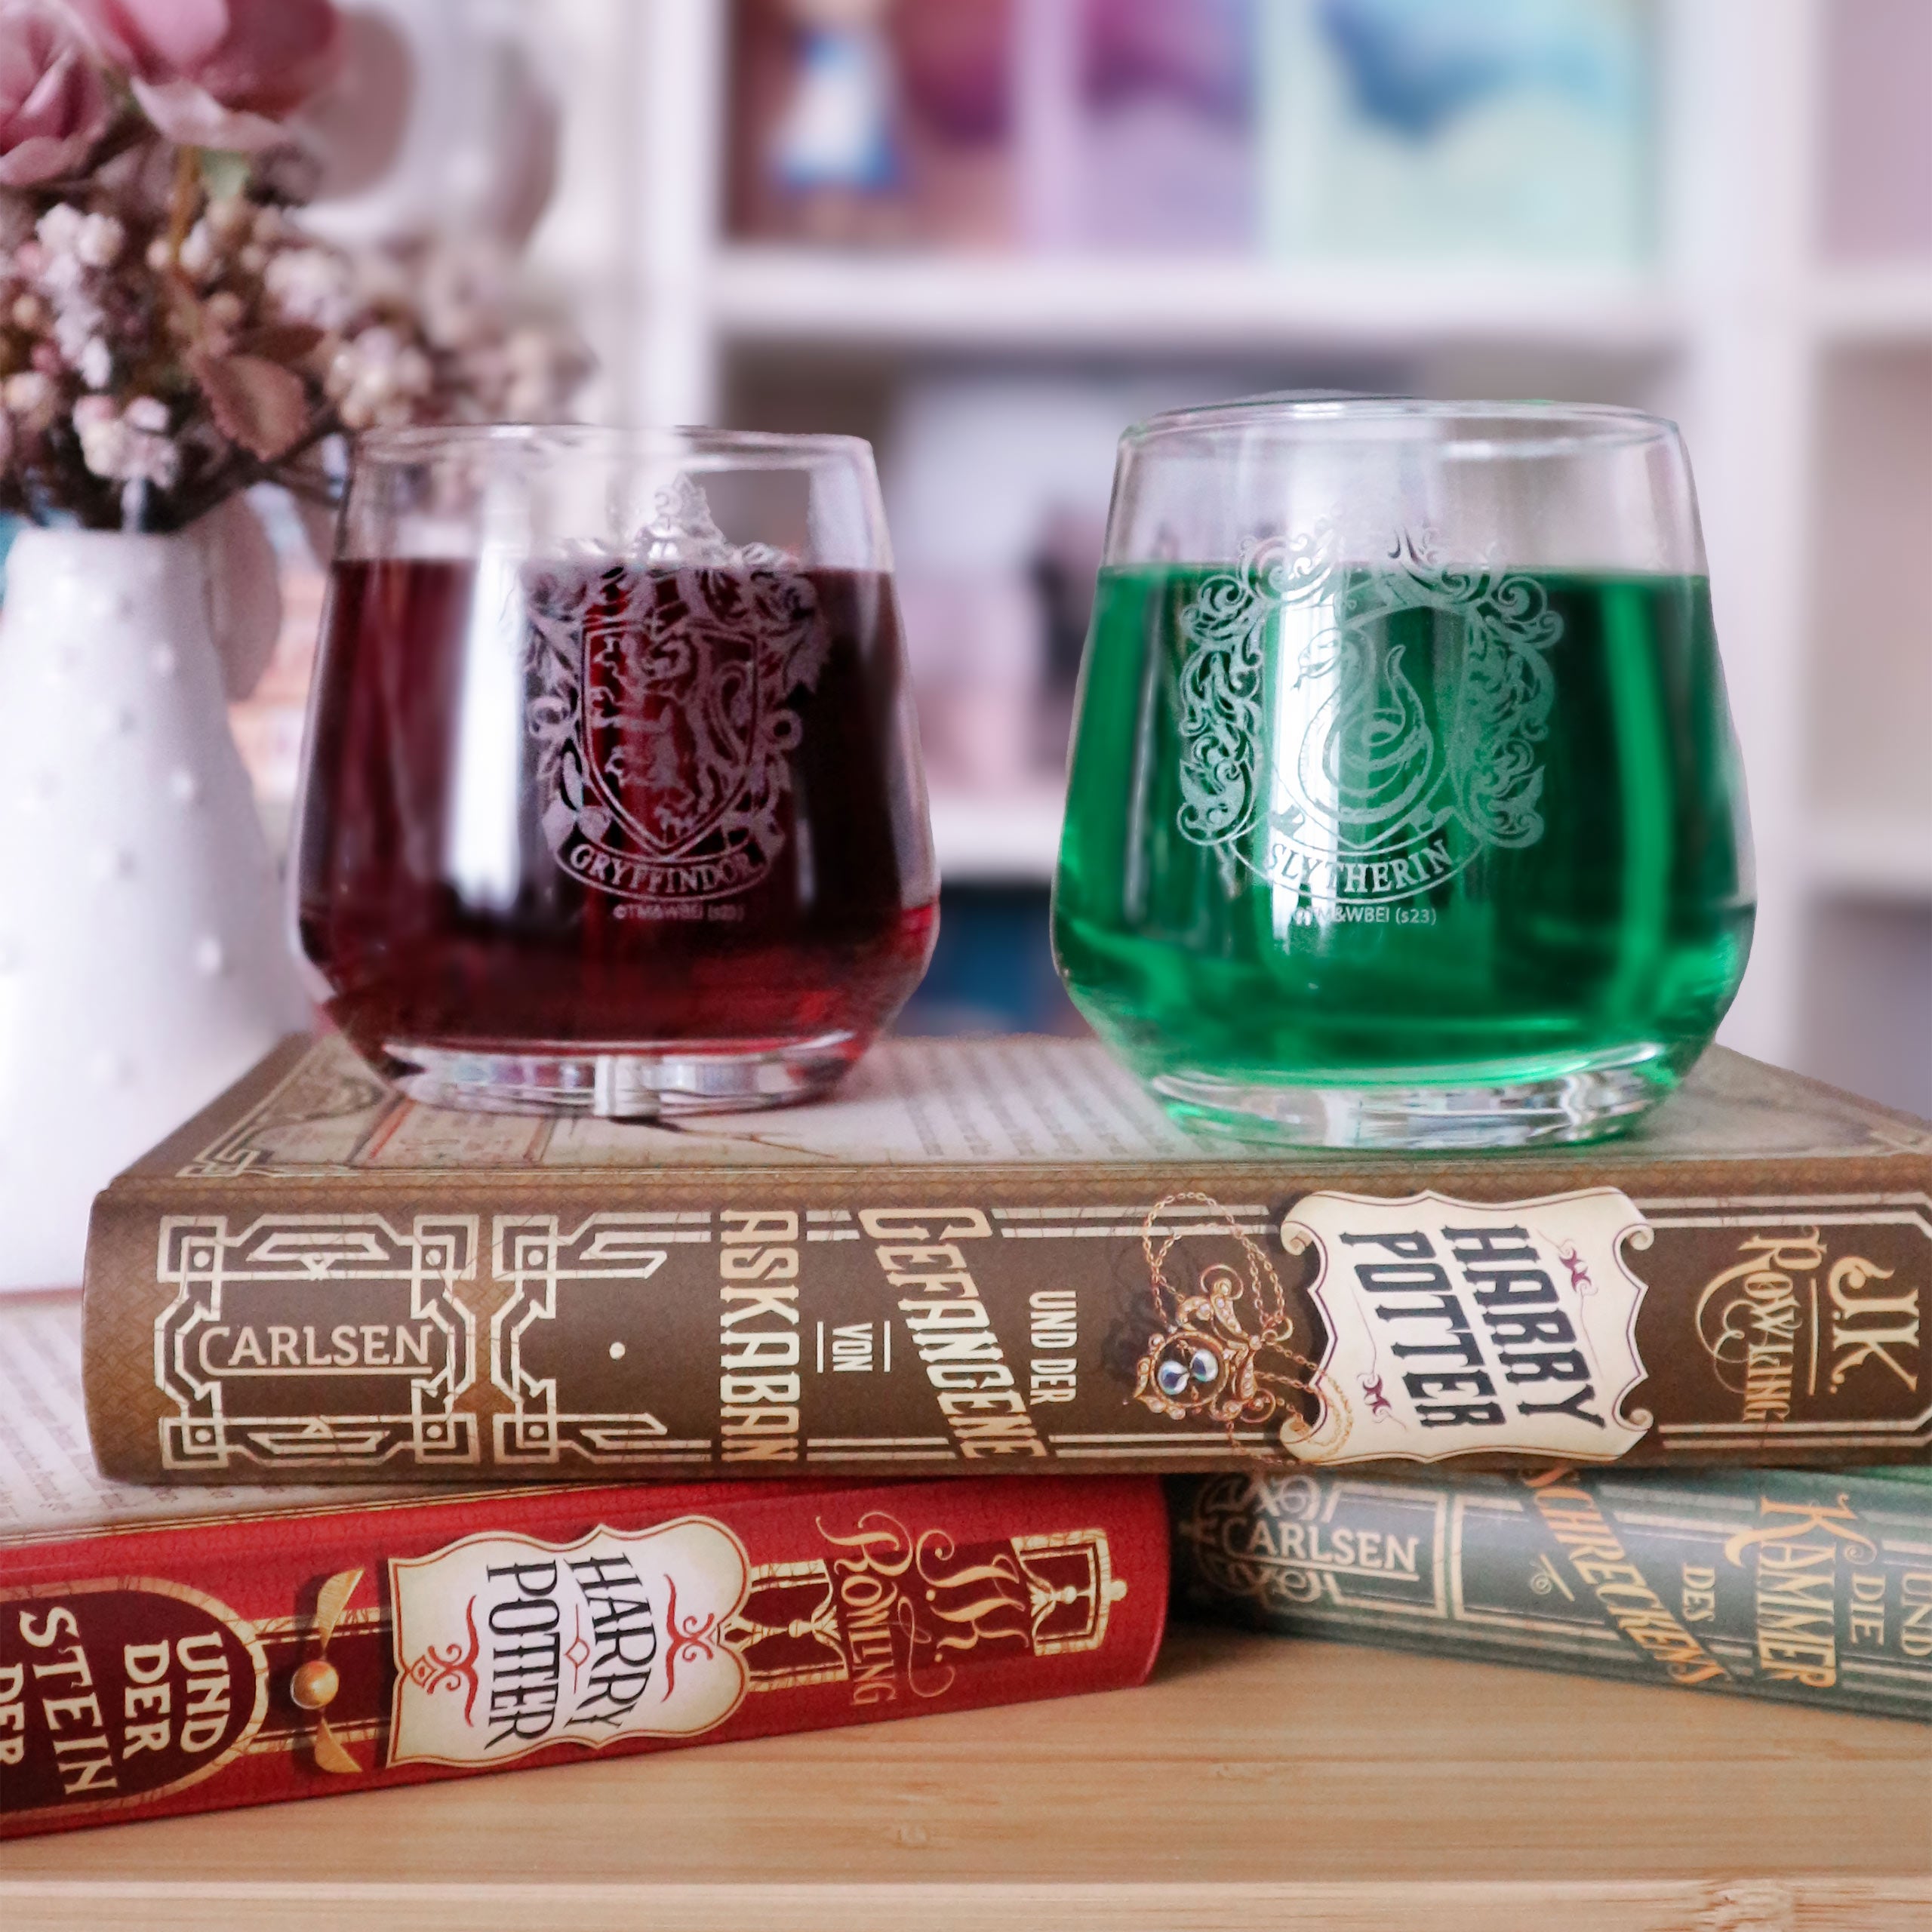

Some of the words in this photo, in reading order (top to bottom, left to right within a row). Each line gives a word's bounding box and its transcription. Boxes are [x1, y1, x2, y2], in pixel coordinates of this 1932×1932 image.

[571, 844, 755, 893] GRYFFINDOR
[1271, 839, 1454, 894] SLYTHERIN
[1395, 907, 1438, 925] (s23)
[198, 1324, 435, 1375] CARLSEN
[719, 1209, 801, 1461] ASKABAN
[832, 1322, 873, 1372] VON
[857, 1207, 1049, 1460] GEFANGENE
[1029, 1291, 1078, 1349] UND
[1339, 1230, 1509, 1430] POTTER
[1440, 1224, 1606, 1430] HARRY
[1696, 1226, 1828, 1423] ROWLING
[1828, 1256, 1920, 1395] J.K.
[1029, 1358, 1078, 1406] DER
[815, 1511, 914, 1706] ROWLING
[1222, 1517, 1420, 1582] CARLSEN
[1681, 1563, 1716, 1622] DES
[1724, 1492, 1878, 1688] KAMMER
[1850, 1572, 1886, 1646] DIE
[484, 1558, 561, 1751] POTTER
[563, 1552, 657, 1729] HARRY
[1901, 1572, 1932, 1657] UND
[19, 1606, 118, 1795] STEIN
[122, 1638, 171, 1761] DER
[176, 1631, 231, 1752] UND
